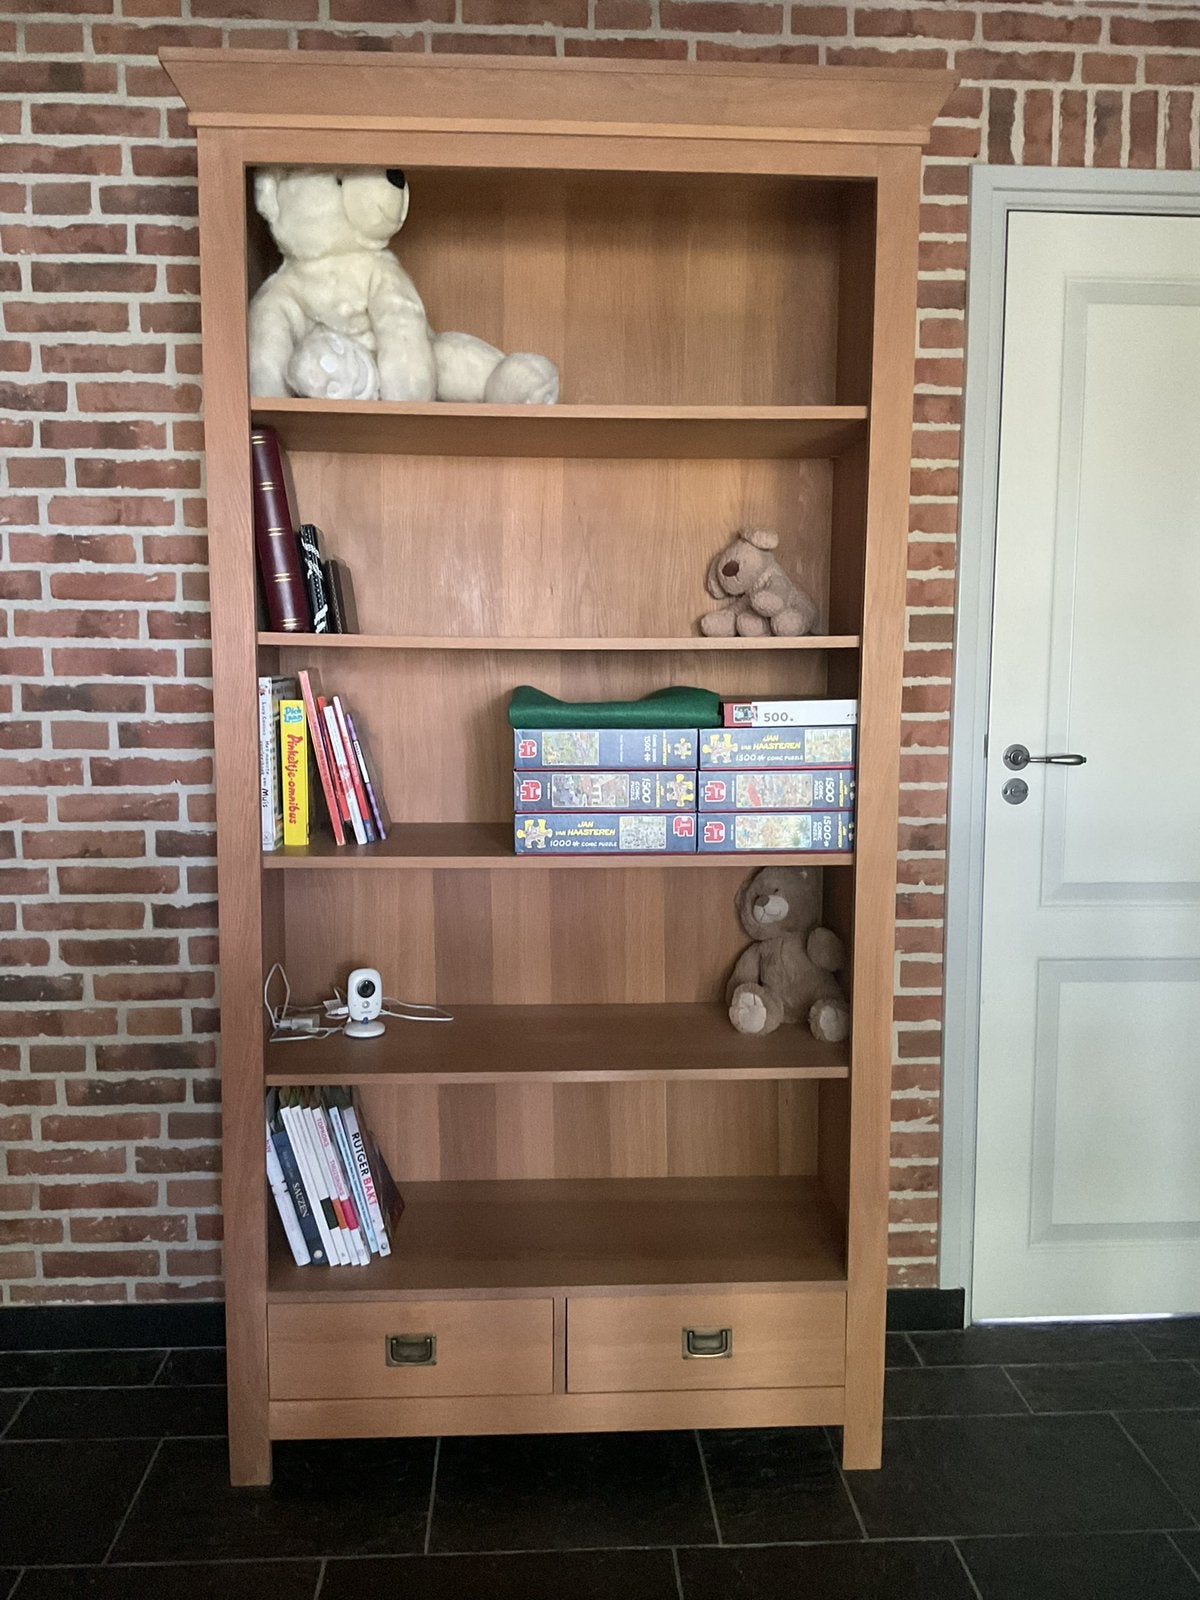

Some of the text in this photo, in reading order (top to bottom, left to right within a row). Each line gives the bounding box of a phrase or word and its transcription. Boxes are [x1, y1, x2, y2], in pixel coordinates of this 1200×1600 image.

[735, 754, 756, 762] 1500
[284, 733, 304, 825] Pinkeltje-omnibus
[641, 777, 651, 803] 1500
[825, 777, 835, 803] 1500
[567, 828, 616, 836] HAASTEREN
[823, 815, 832, 841] 1500
[550, 839, 572, 847] 1000
[351, 1132, 369, 1176] RUTGER
[362, 1177, 378, 1206] BAKT
[292, 1182, 309, 1218] SAUZEN
